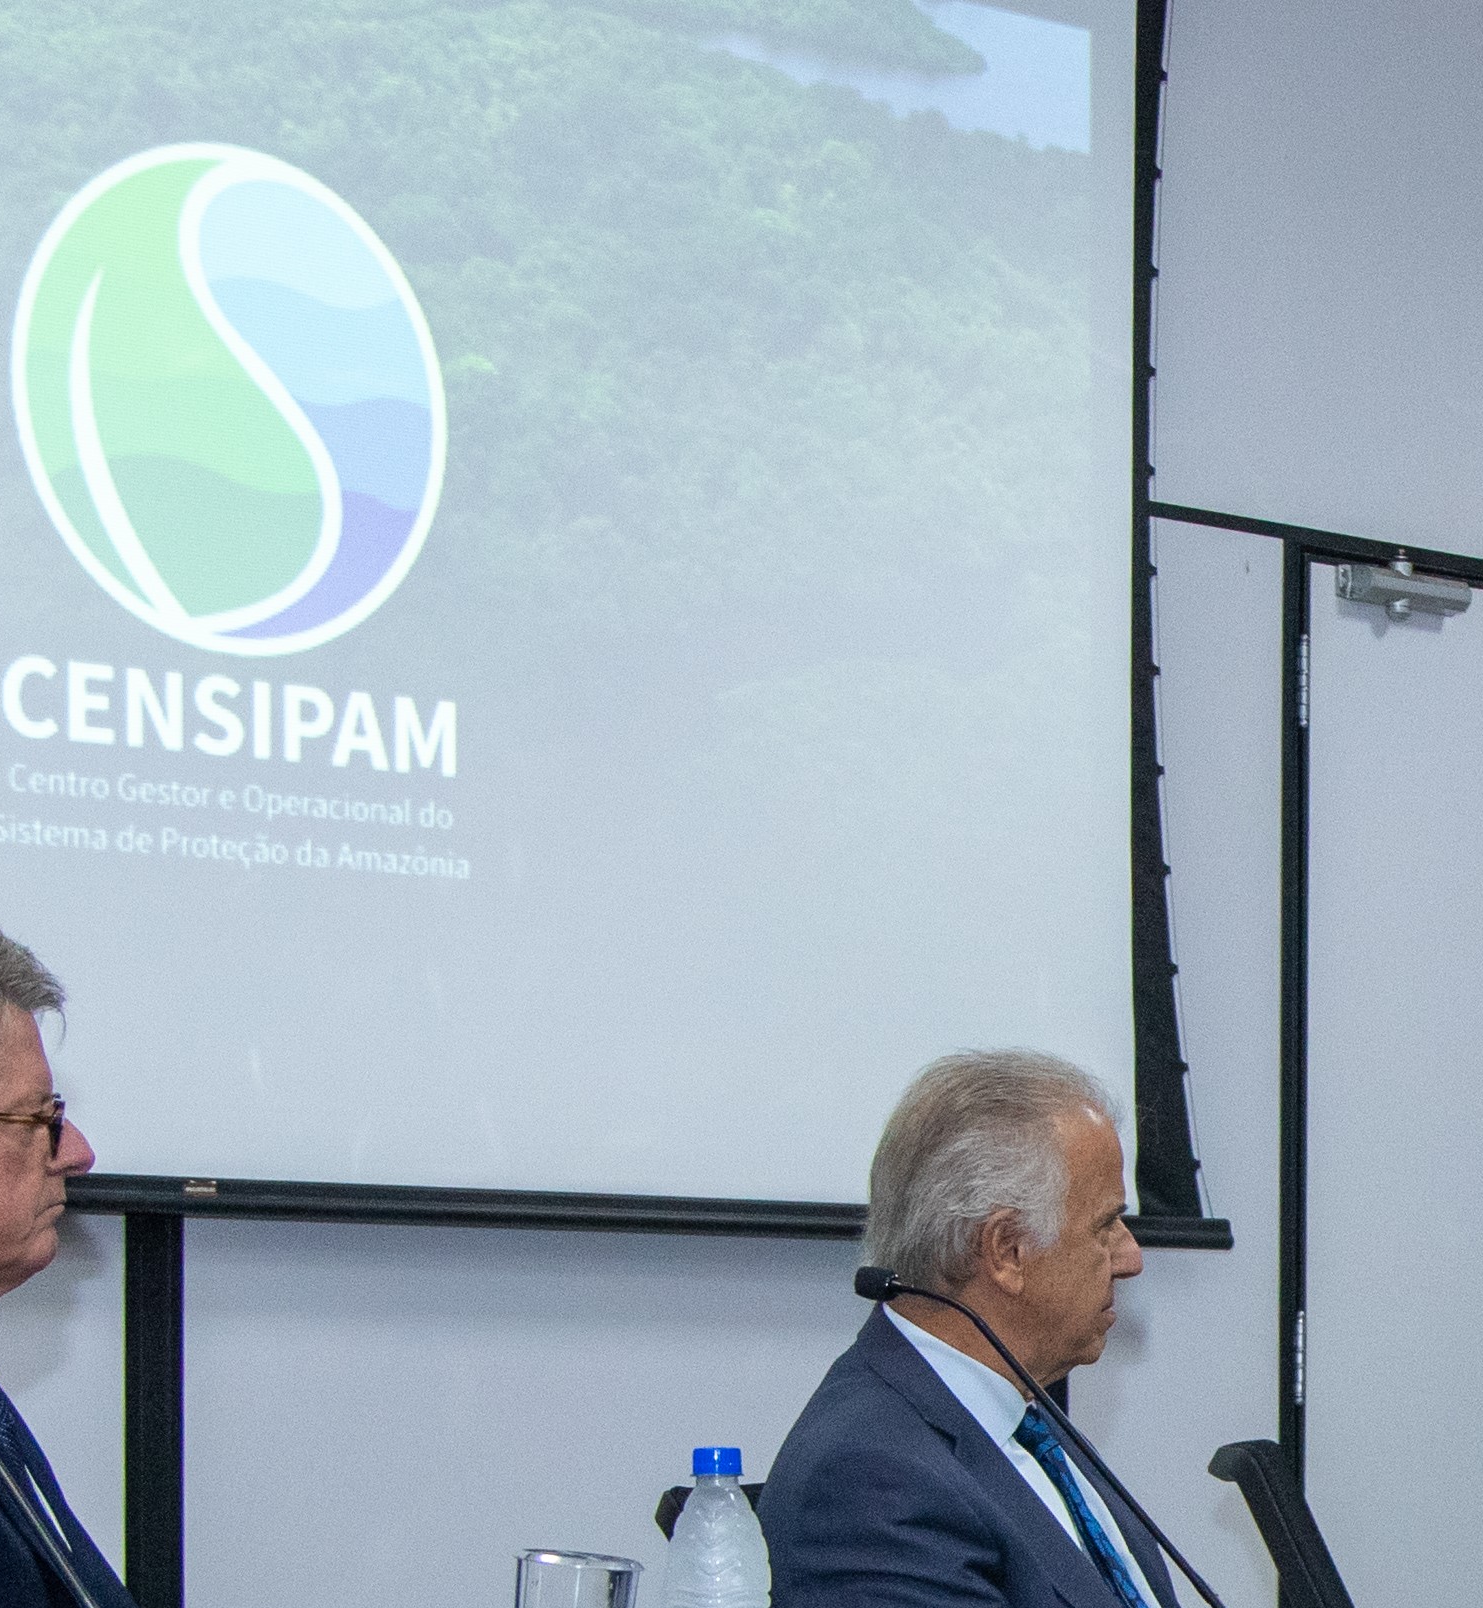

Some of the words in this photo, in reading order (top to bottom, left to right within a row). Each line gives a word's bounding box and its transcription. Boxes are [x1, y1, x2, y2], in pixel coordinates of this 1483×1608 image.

[1, 653, 457, 778] CENSIPAM
[8, 762, 110, 801] Centro
[117, 773, 211, 809] Gestor
[219, 788, 237, 810] e
[243, 784, 414, 827] Operacional
[419, 799, 454, 830] do
[117, 823, 153, 855] de
[162, 826, 289, 869] Proteção
[296, 836, 330, 868] da
[337, 841, 471, 880] Amazônia
